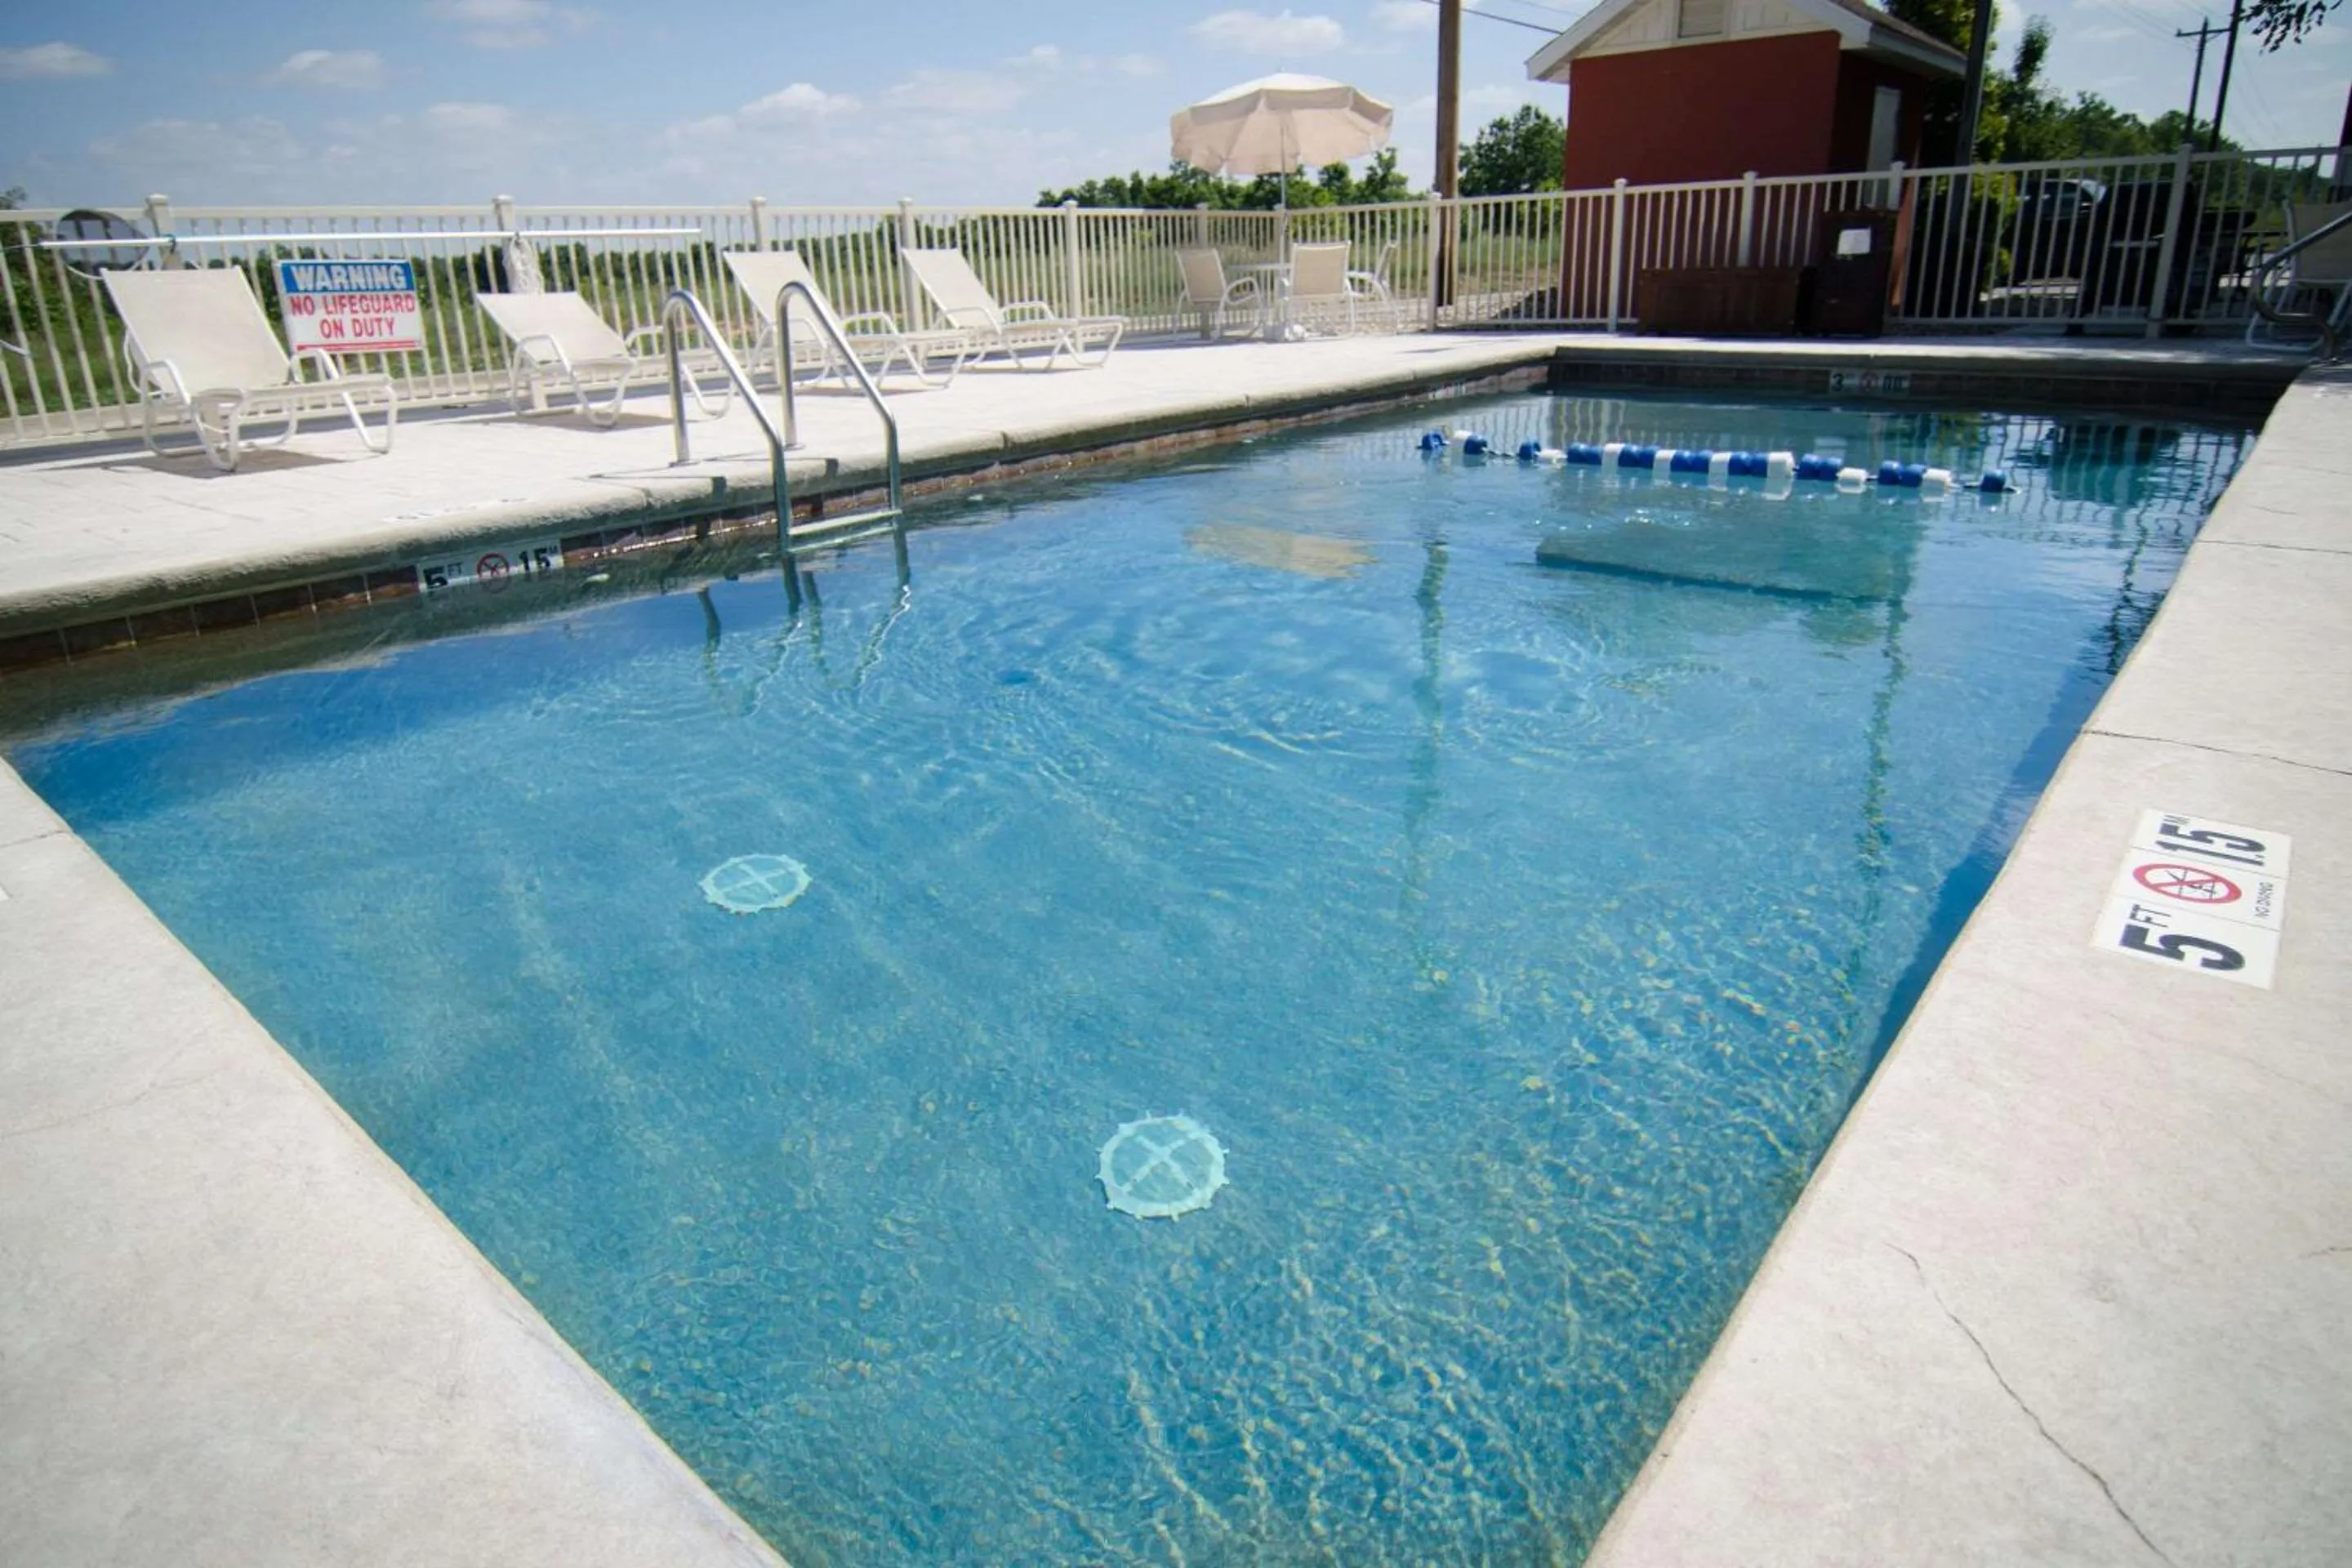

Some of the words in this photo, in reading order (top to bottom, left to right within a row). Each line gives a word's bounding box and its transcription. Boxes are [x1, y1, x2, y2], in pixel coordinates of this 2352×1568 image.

[290, 264, 407, 292] WARNING
[290, 296, 315, 316] NO
[322, 294, 415, 314] LIFEGUARD
[319, 318, 345, 339] ON
[351, 317, 394, 337] DUTY
